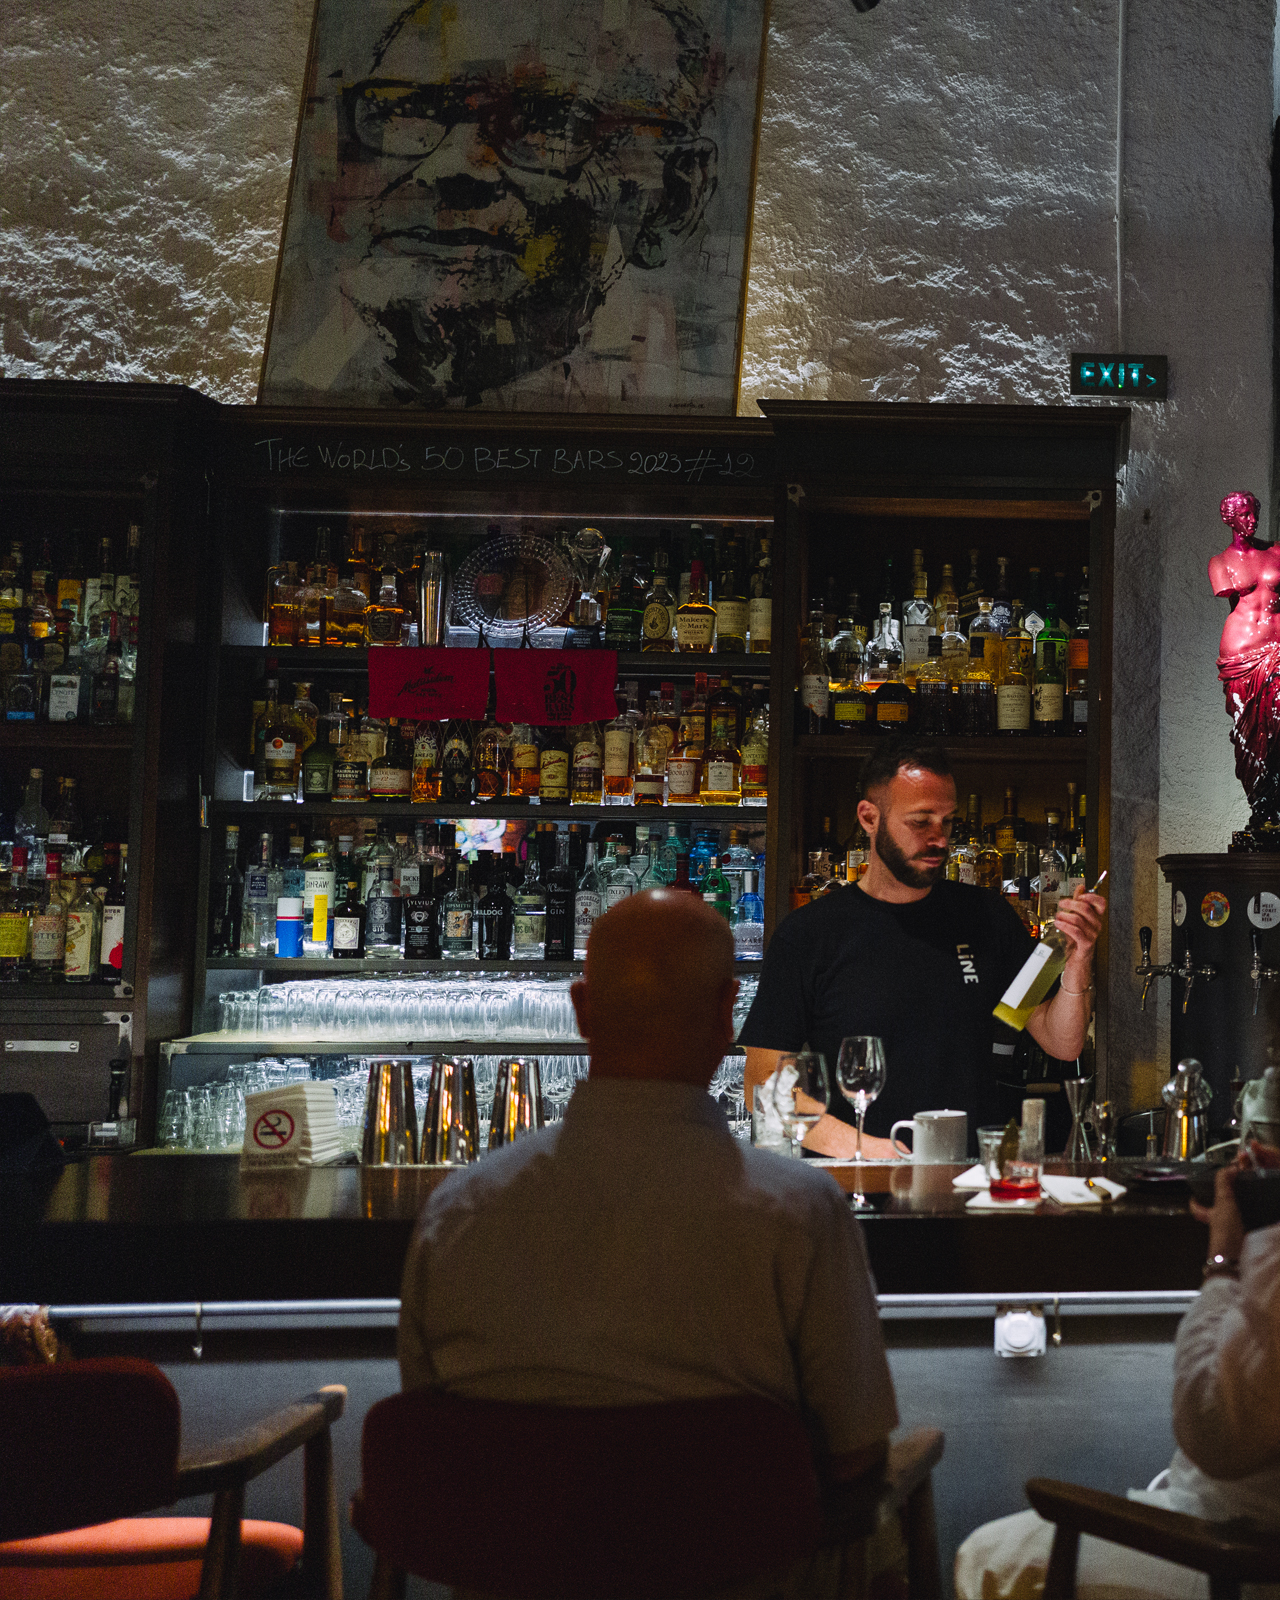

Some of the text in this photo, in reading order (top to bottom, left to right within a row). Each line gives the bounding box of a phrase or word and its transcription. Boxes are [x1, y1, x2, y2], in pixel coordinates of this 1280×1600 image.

[1080, 362, 1144, 388] EXIT
[255, 438, 309, 471] THE
[421, 446, 465, 470] 50
[475, 446, 542, 473] BEST
[552, 448, 624, 474] BARS
[627, 450, 682, 475] 2023
[543, 669, 577, 694] 50
[406, 899, 434, 908] SYLVIUS
